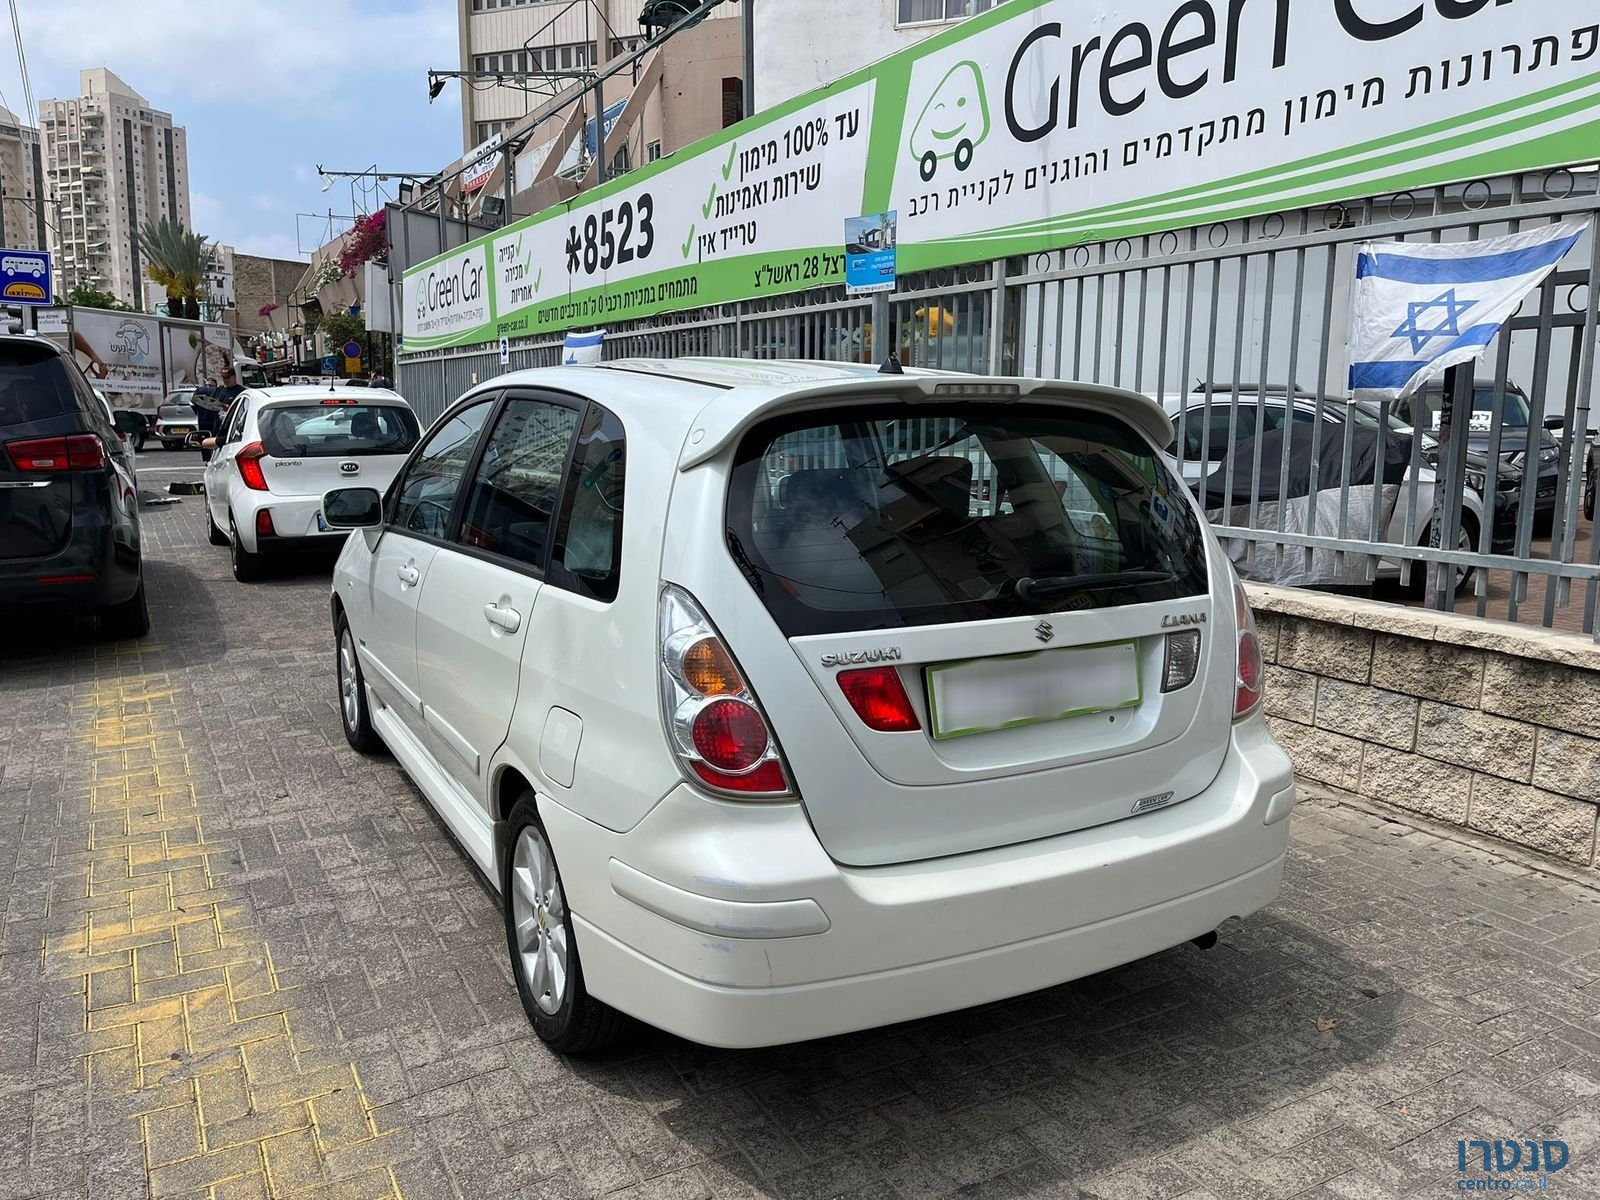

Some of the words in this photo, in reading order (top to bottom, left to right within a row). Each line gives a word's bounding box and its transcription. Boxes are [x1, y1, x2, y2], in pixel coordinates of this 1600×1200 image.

[1004, 0, 1290, 143] Green
[1405, 24, 1600, 99] פתרונות
[1284, 77, 1385, 136] מימון
[784, 117, 829, 158] 100%
[835, 108, 860, 141] עד
[1123, 107, 1265, 167] מתקדמים
[739, 140, 778, 182] מימון
[1025, 148, 1109, 190] והוגנים
[772, 163, 821, 201] שירות
[947, 168, 1015, 209] לקניית
[715, 180, 768, 219] ואמינות
[908, 190, 940, 217] רכב
[698, 232, 716, 263] אין
[720, 221, 757, 251] טרייד
[499, 244, 515, 264] קנייה
[803, 255, 819, 279] 28
[428, 272, 460, 312] Green
[461, 258, 483, 303] Car
[505, 264, 523, 284] מכירה
[754, 264, 800, 288] ראשל"צ
[511, 284, 533, 305] אחריות
[605, 293, 622, 312] רכבי
[623, 286, 656, 310] במכירת
[658, 276, 698, 302] מתמחים
[537, 306, 559, 324] חדשים
[559, 300, 582, 321] ורכבים
[598, 295, 604, 314] 0
[497, 314, 528, 337] green-car.co.il
[1161, 612, 1207, 628] LIANA
[821, 647, 902, 667] SUZUKI
